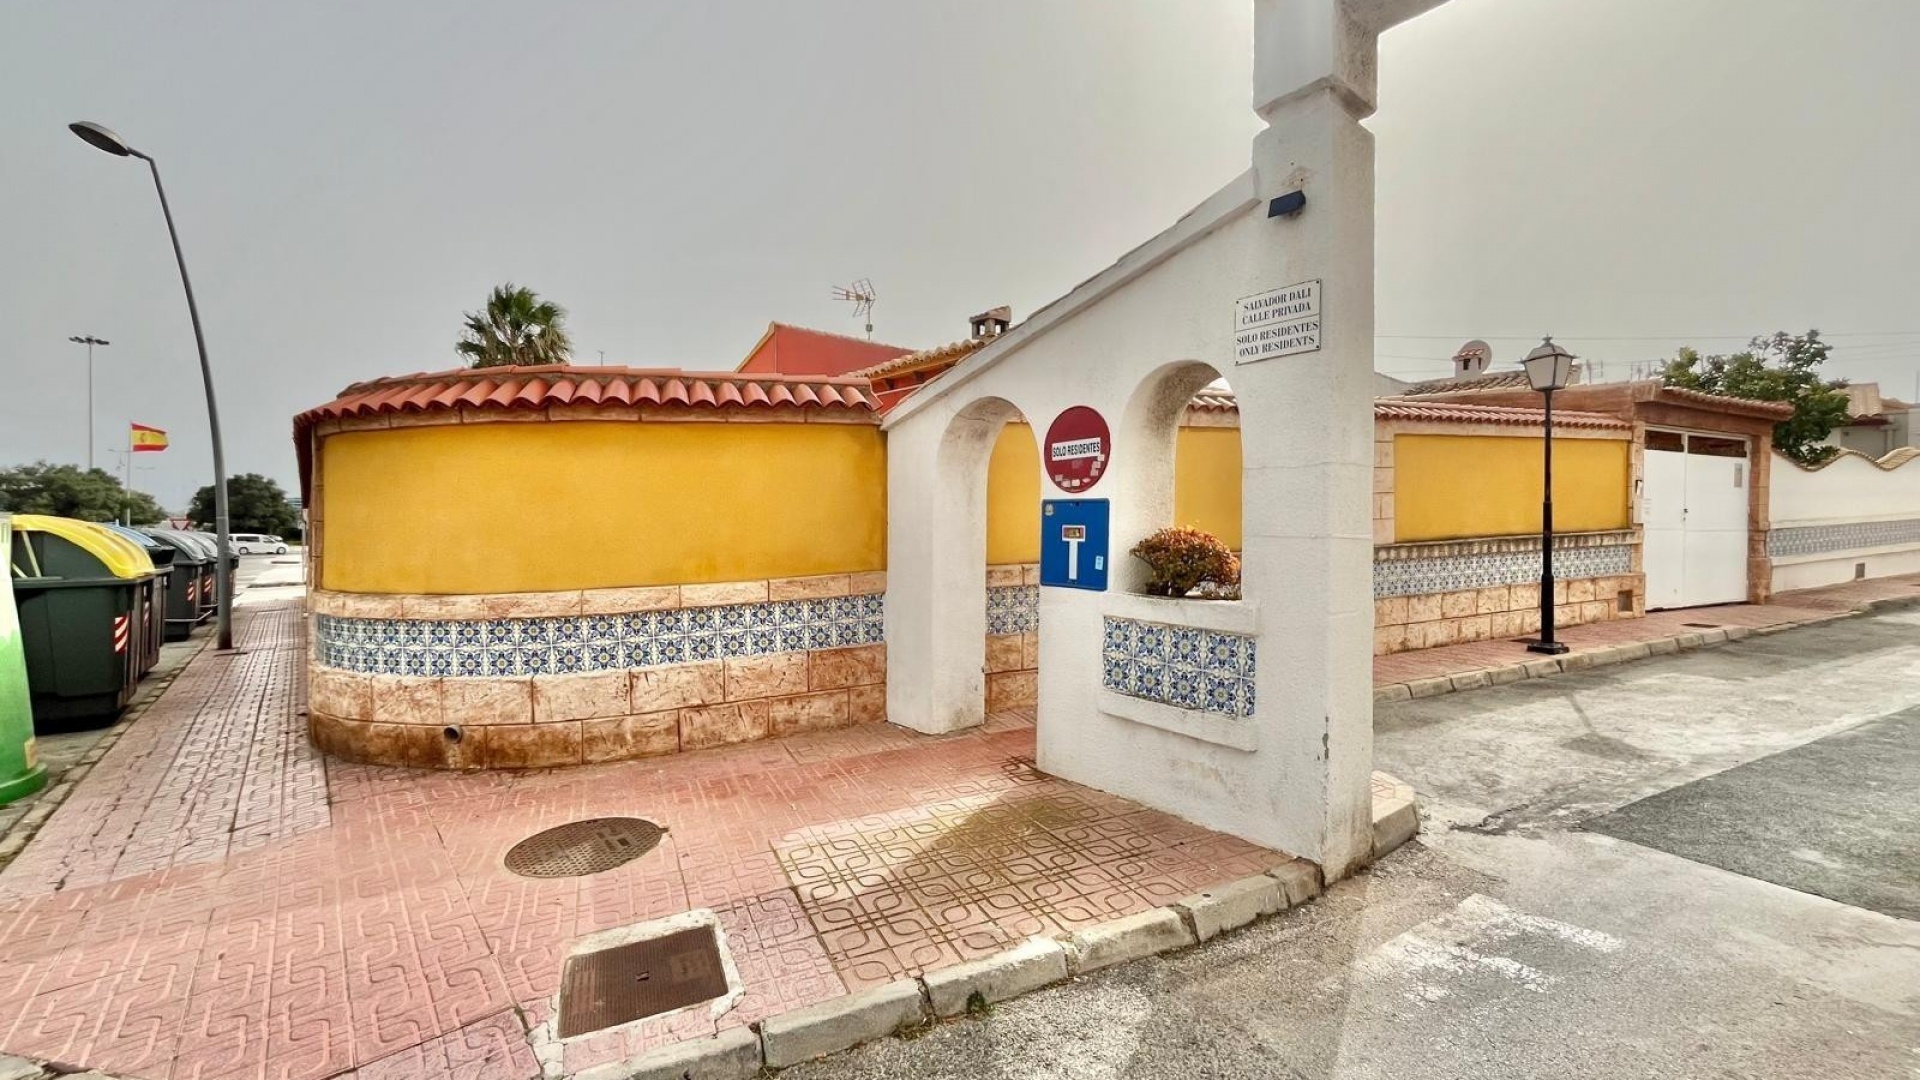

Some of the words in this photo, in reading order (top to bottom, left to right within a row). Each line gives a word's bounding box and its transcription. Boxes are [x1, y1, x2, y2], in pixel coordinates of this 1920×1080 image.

[1242, 310, 1270, 325] CALLE
[1272, 301, 1311, 318] PRIVADA
[1244, 293, 1287, 311] SALVADOR
[1236, 333, 1258, 345] SOLO
[1260, 321, 1319, 341] RESIDENTES
[1239, 345, 1259, 357] ONLY
[1262, 335, 1315, 353] RESIDENTS
[1053, 445, 1066, 457] SOLO
[1068, 441, 1100, 456] RESIDENTES
